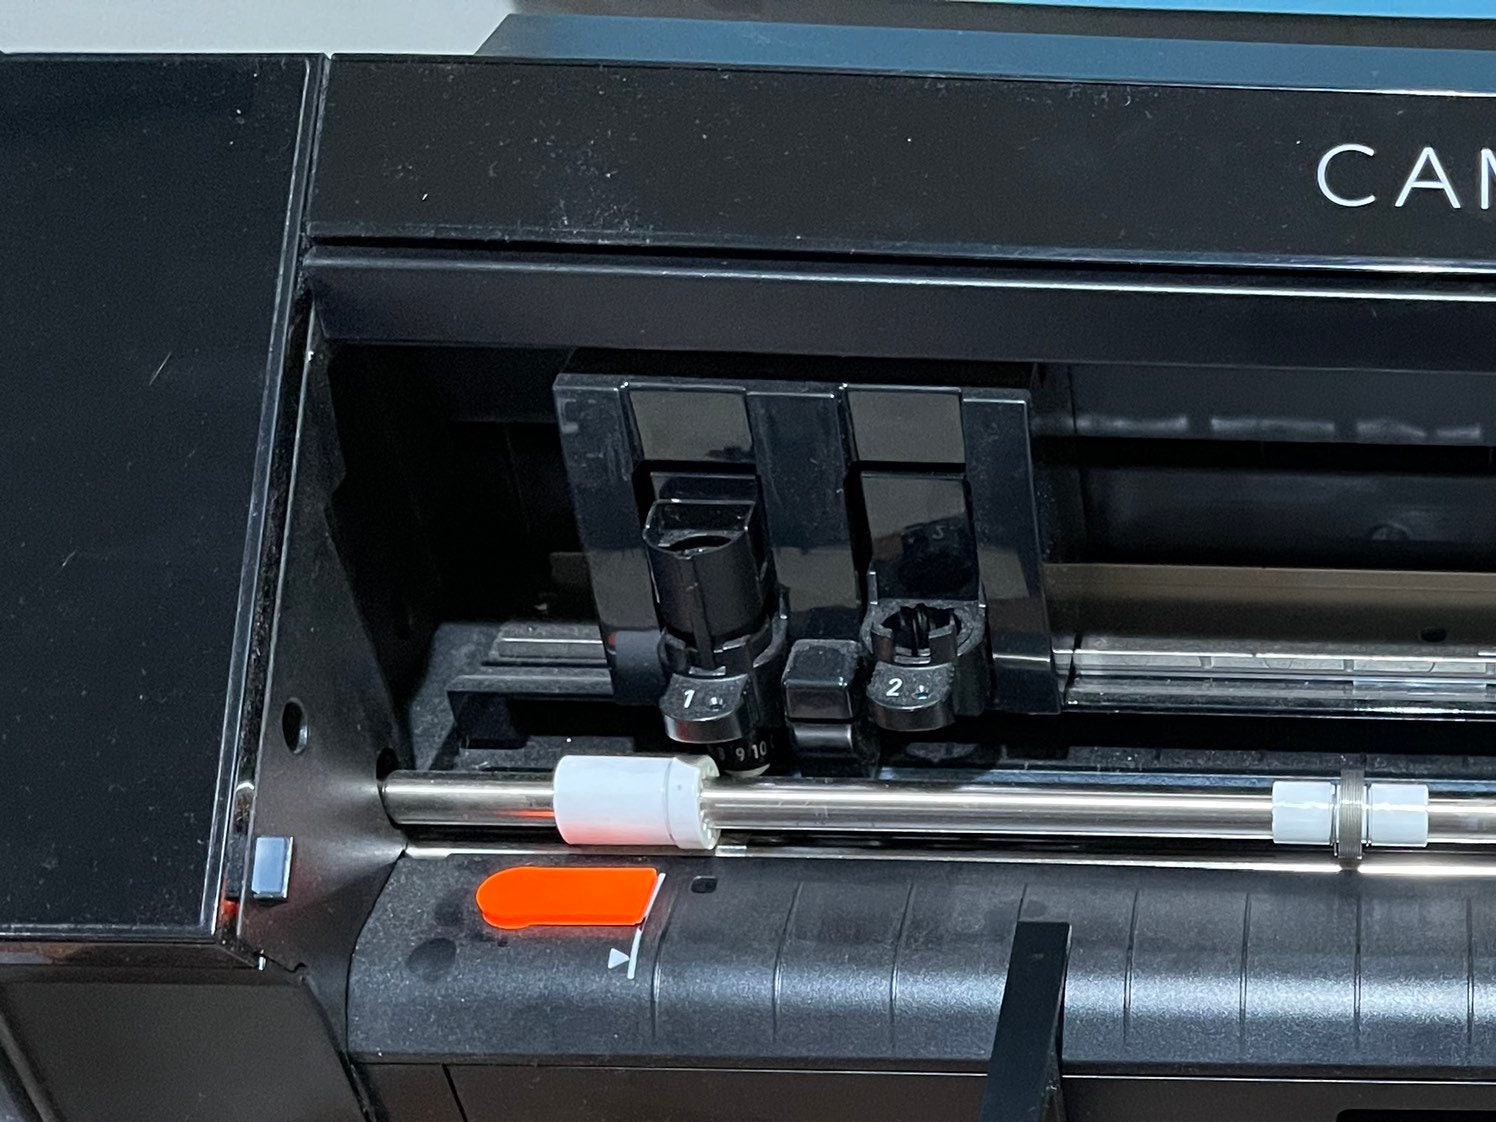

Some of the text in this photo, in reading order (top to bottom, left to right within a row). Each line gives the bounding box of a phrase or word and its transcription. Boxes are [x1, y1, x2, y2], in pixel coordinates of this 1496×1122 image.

[886, 677, 903, 697] 2
[683, 689, 696, 708] 1
[751, 740, 767, 759] 10
